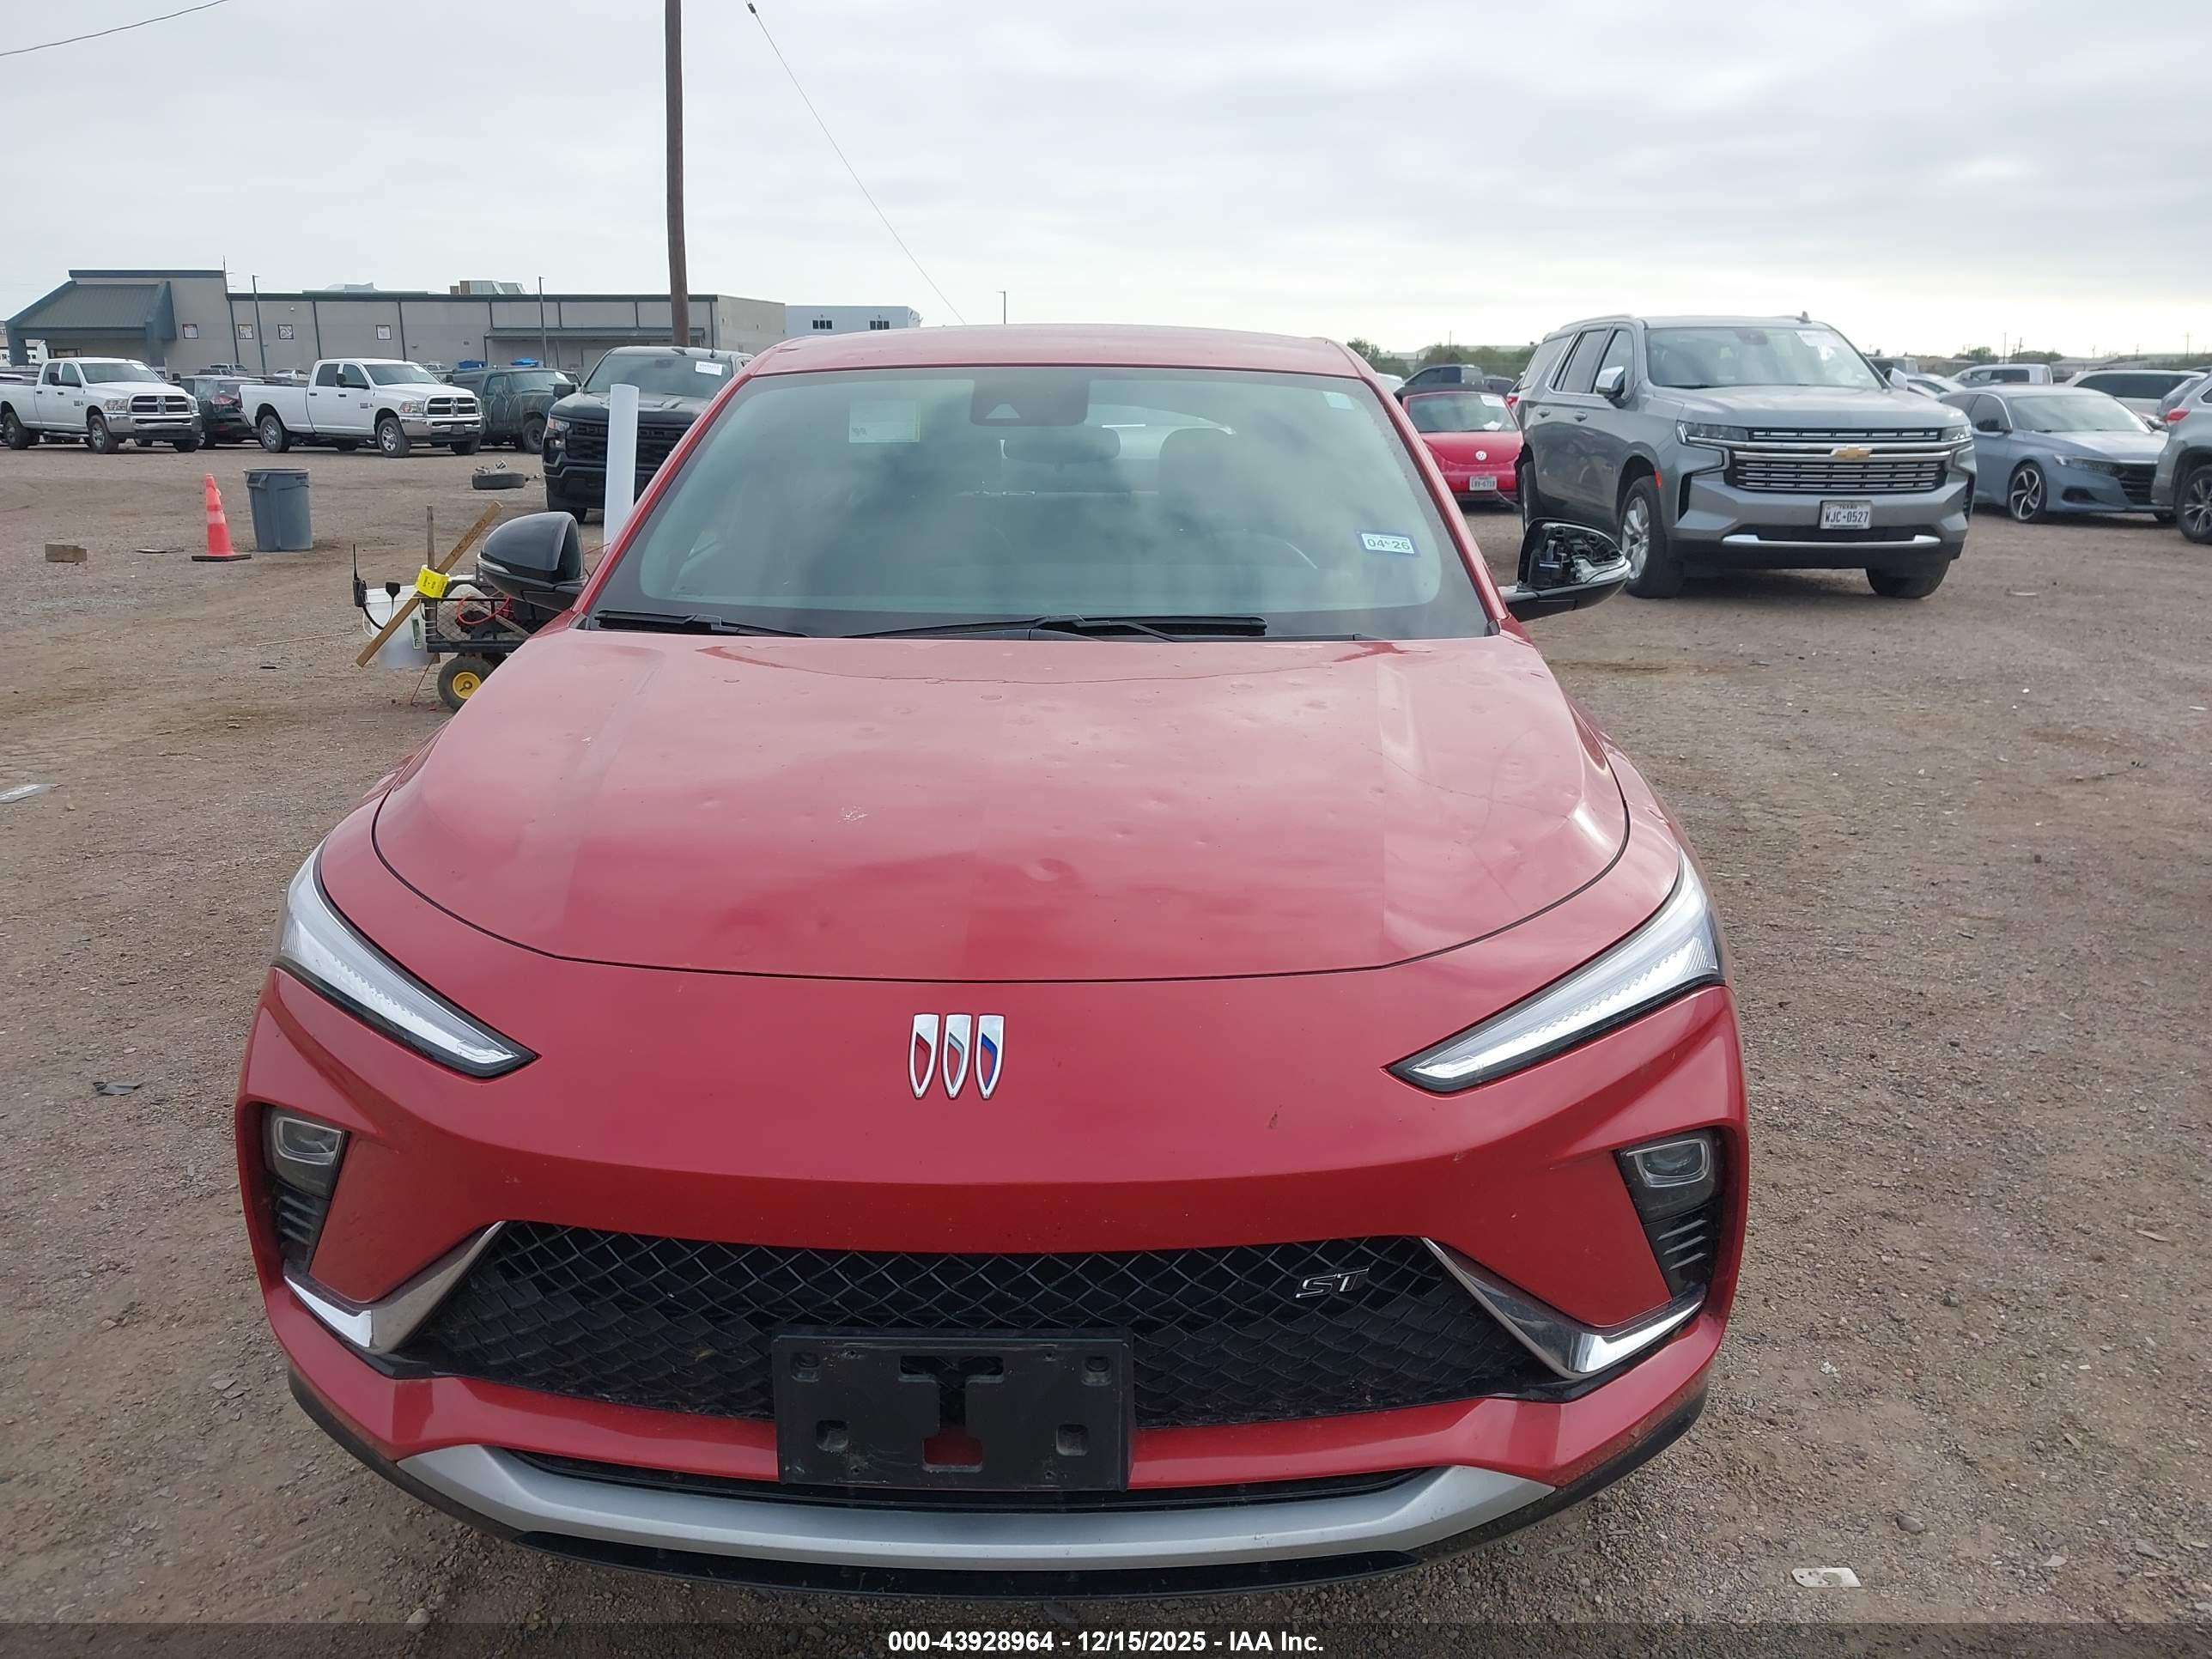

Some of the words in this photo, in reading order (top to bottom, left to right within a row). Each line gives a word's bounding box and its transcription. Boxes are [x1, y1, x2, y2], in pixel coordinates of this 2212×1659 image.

[1367, 538, 1385, 548] 04
[1392, 541, 1410, 550] 26
[1295, 1267, 1370, 1298] ST
